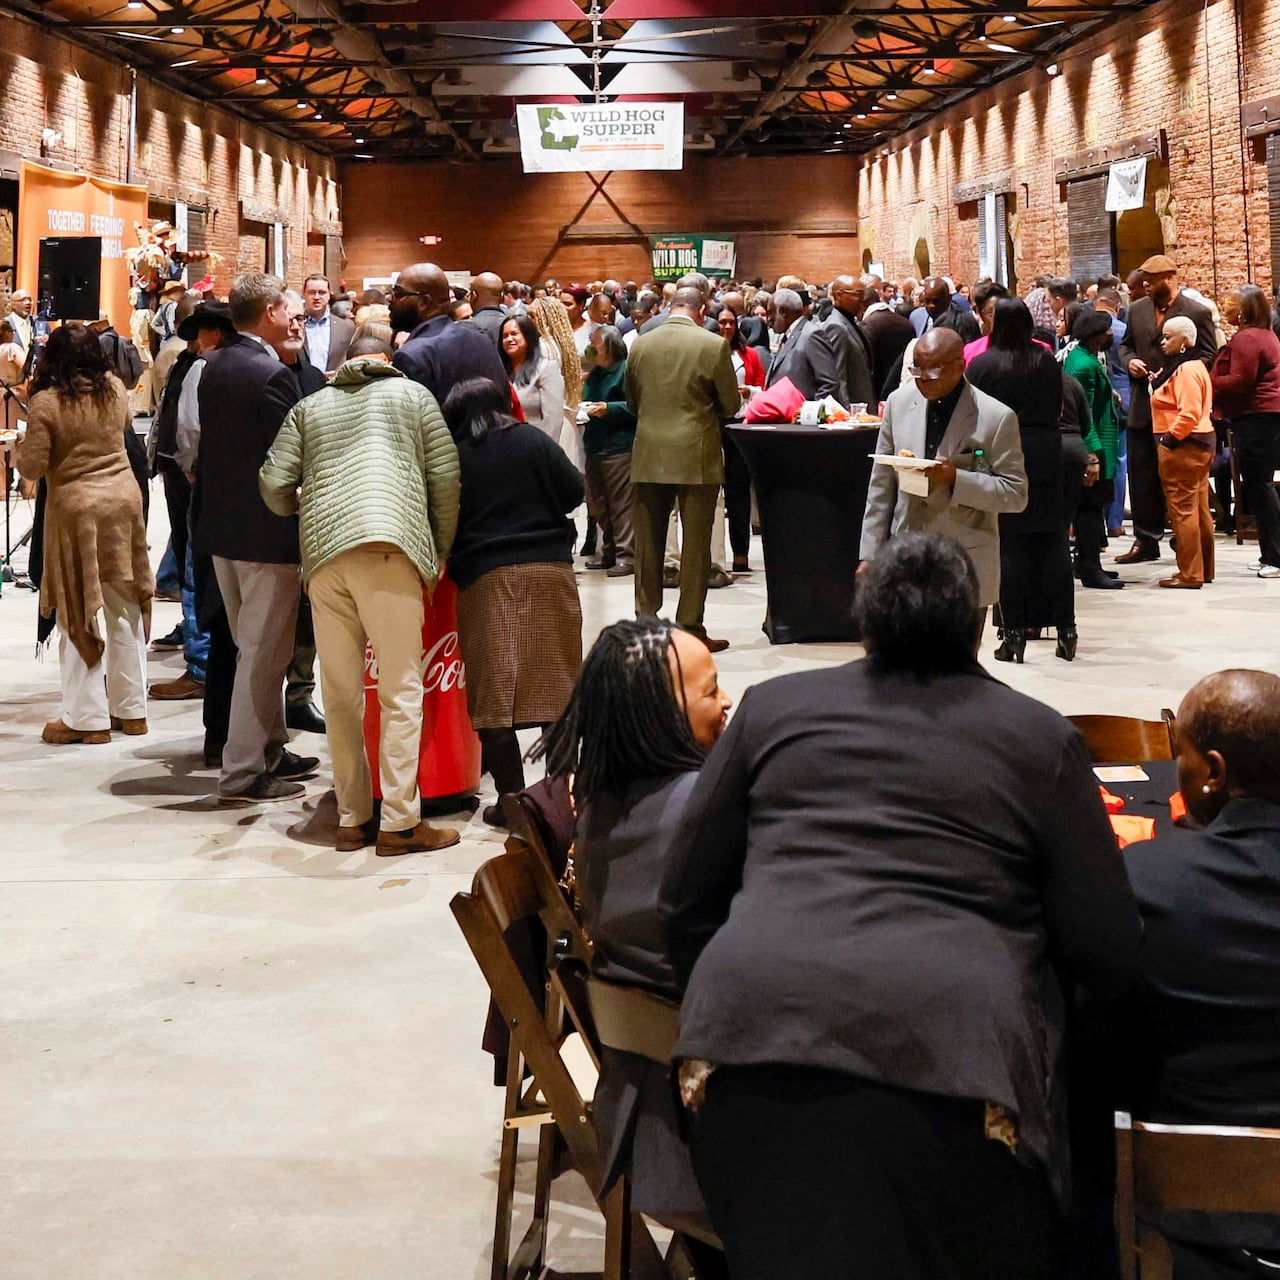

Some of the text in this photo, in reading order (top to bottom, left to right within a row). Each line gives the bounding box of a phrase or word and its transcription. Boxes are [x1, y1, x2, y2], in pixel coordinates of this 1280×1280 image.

[571, 110, 665, 123] WILD HOG
[583, 123, 655, 136] SUPPER
[47, 209, 85, 232] TOGETHER
[90, 214, 124, 237] FEEDING
[652, 249, 698, 268] WILD HOG
